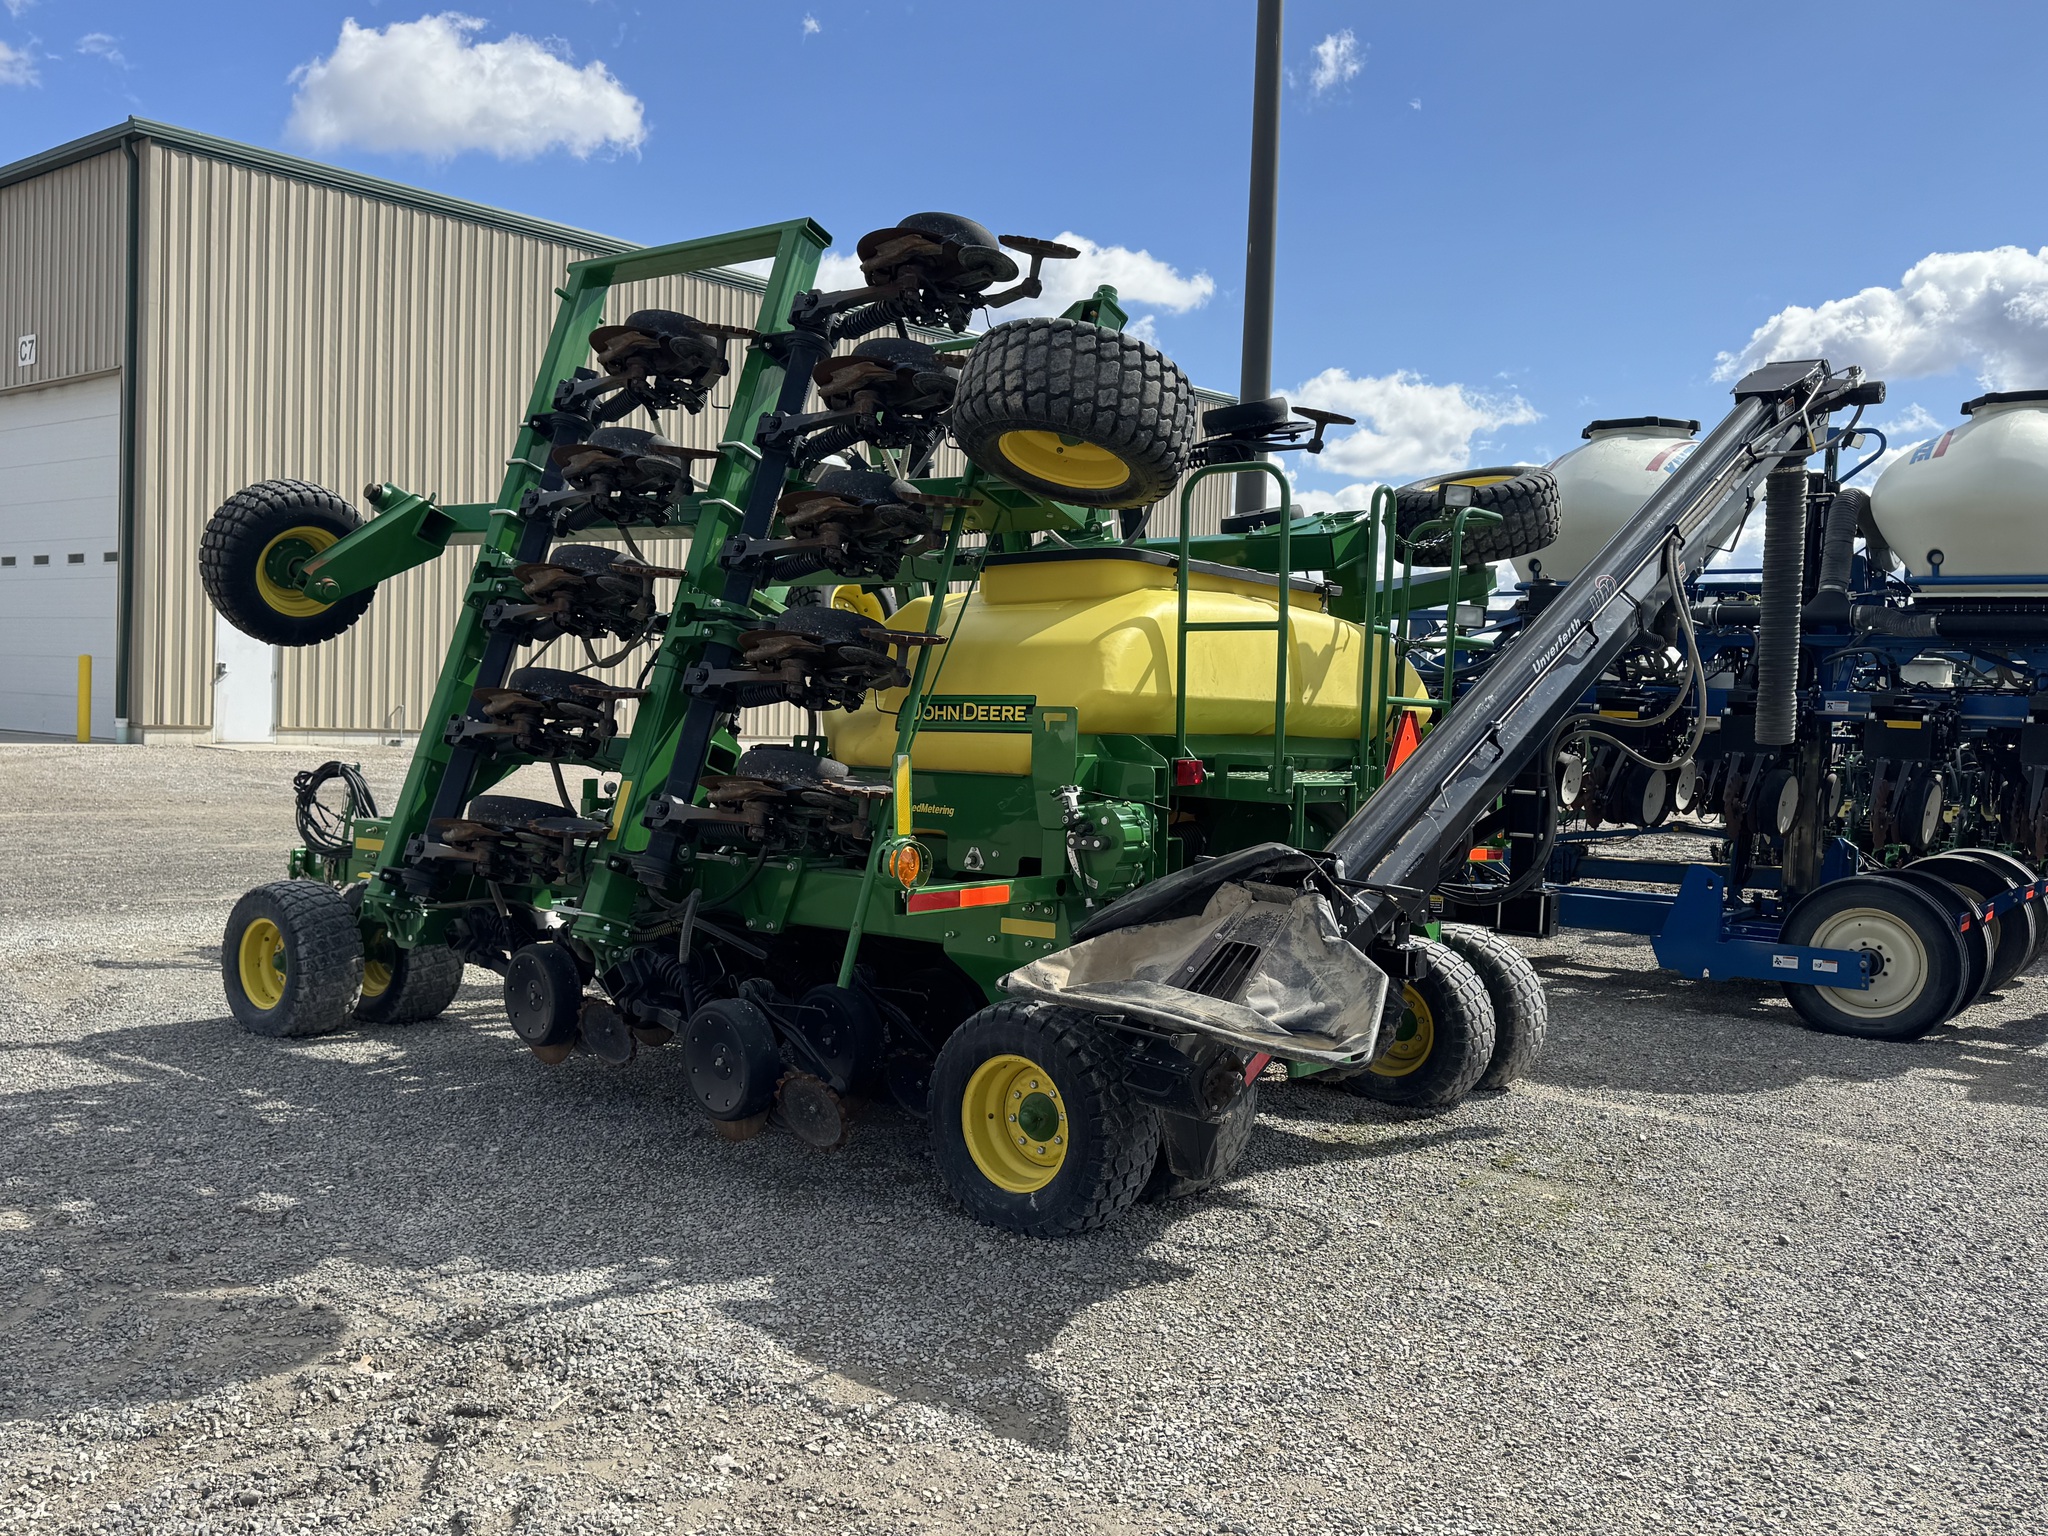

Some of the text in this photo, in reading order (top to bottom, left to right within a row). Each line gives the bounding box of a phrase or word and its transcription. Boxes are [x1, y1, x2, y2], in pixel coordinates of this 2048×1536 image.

[20, 339, 35, 362] C7
[1532, 618, 1582, 674] Unverferth
[962, 702, 1027, 722] DEERE
[911, 802, 955, 818] edMetering
